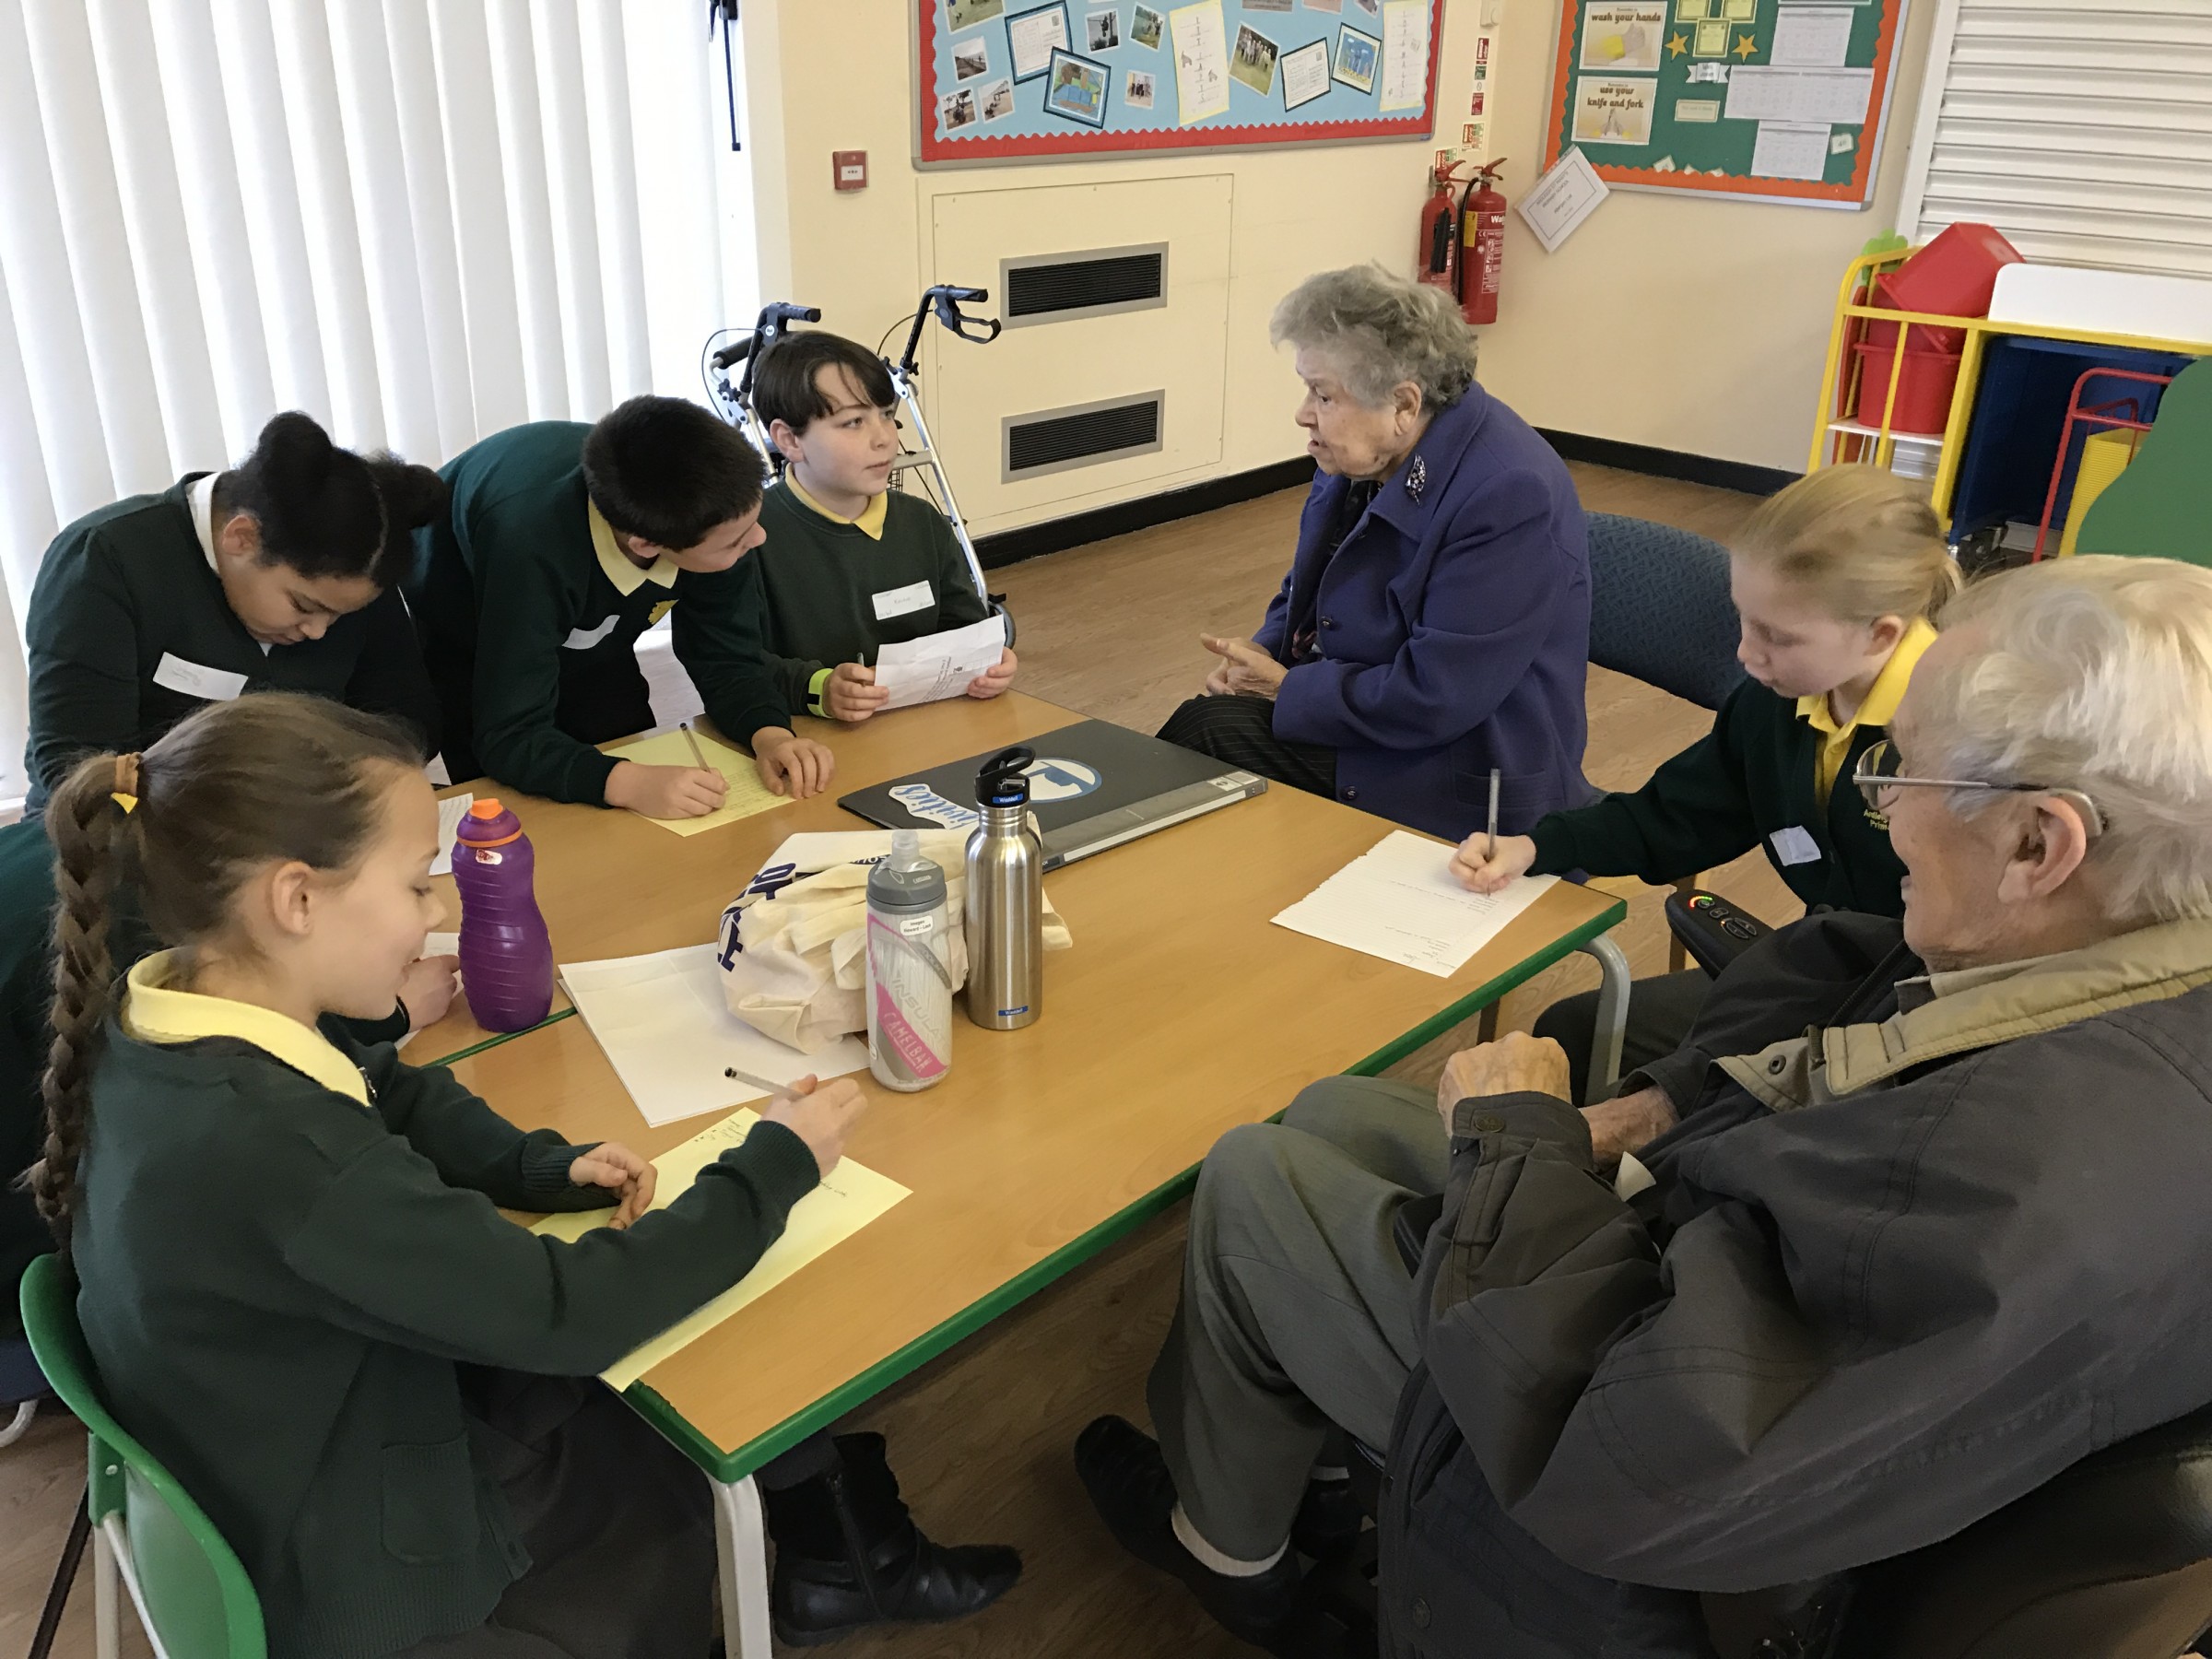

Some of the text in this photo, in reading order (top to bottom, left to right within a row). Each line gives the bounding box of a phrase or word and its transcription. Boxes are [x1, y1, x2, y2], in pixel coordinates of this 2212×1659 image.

[1591, 12, 1661, 24] wash your hands
[1616, 88, 1635, 97] your
[1587, 97, 1644, 110] knife and fork
